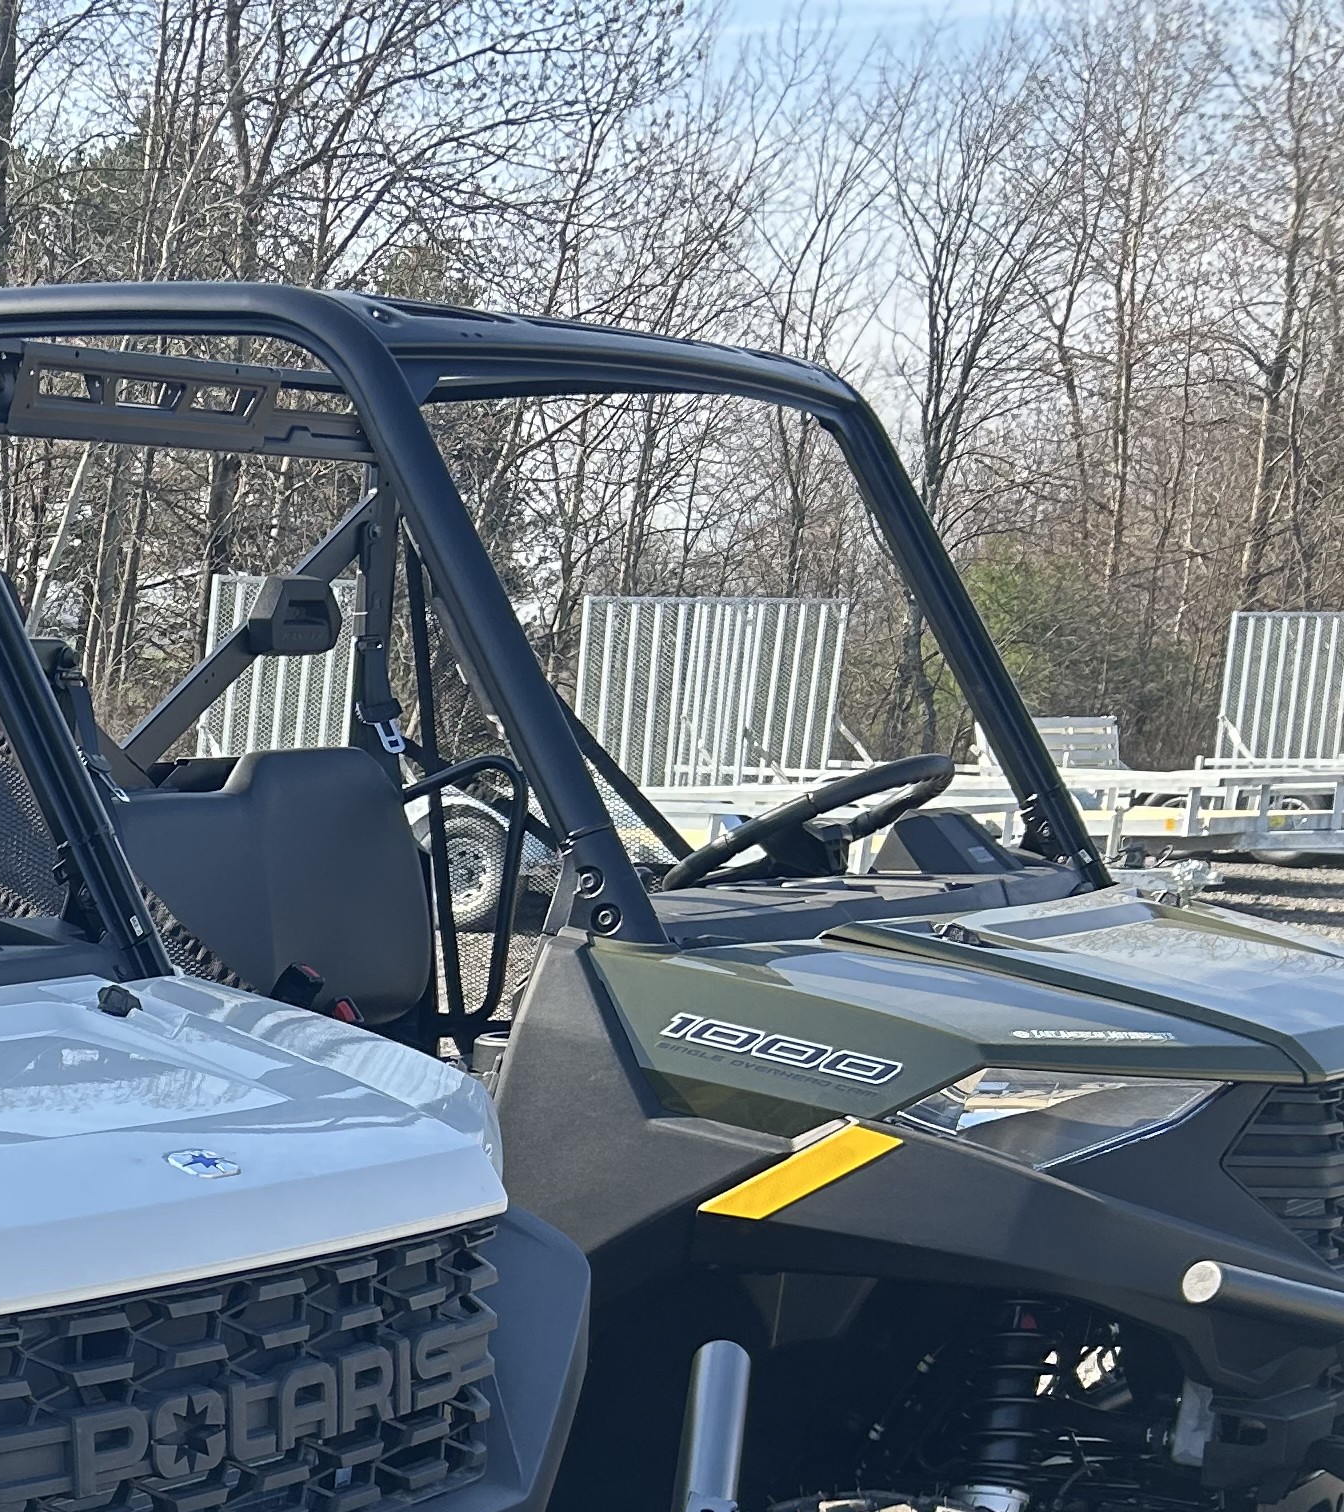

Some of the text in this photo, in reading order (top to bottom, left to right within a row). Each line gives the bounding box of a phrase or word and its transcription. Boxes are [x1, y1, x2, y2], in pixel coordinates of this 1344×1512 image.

[657, 1041, 879, 1098] SINGLE OVERHEAD CAM
[659, 1012, 903, 1085] 1000
[71, 1322, 462, 1500] POLARIS
